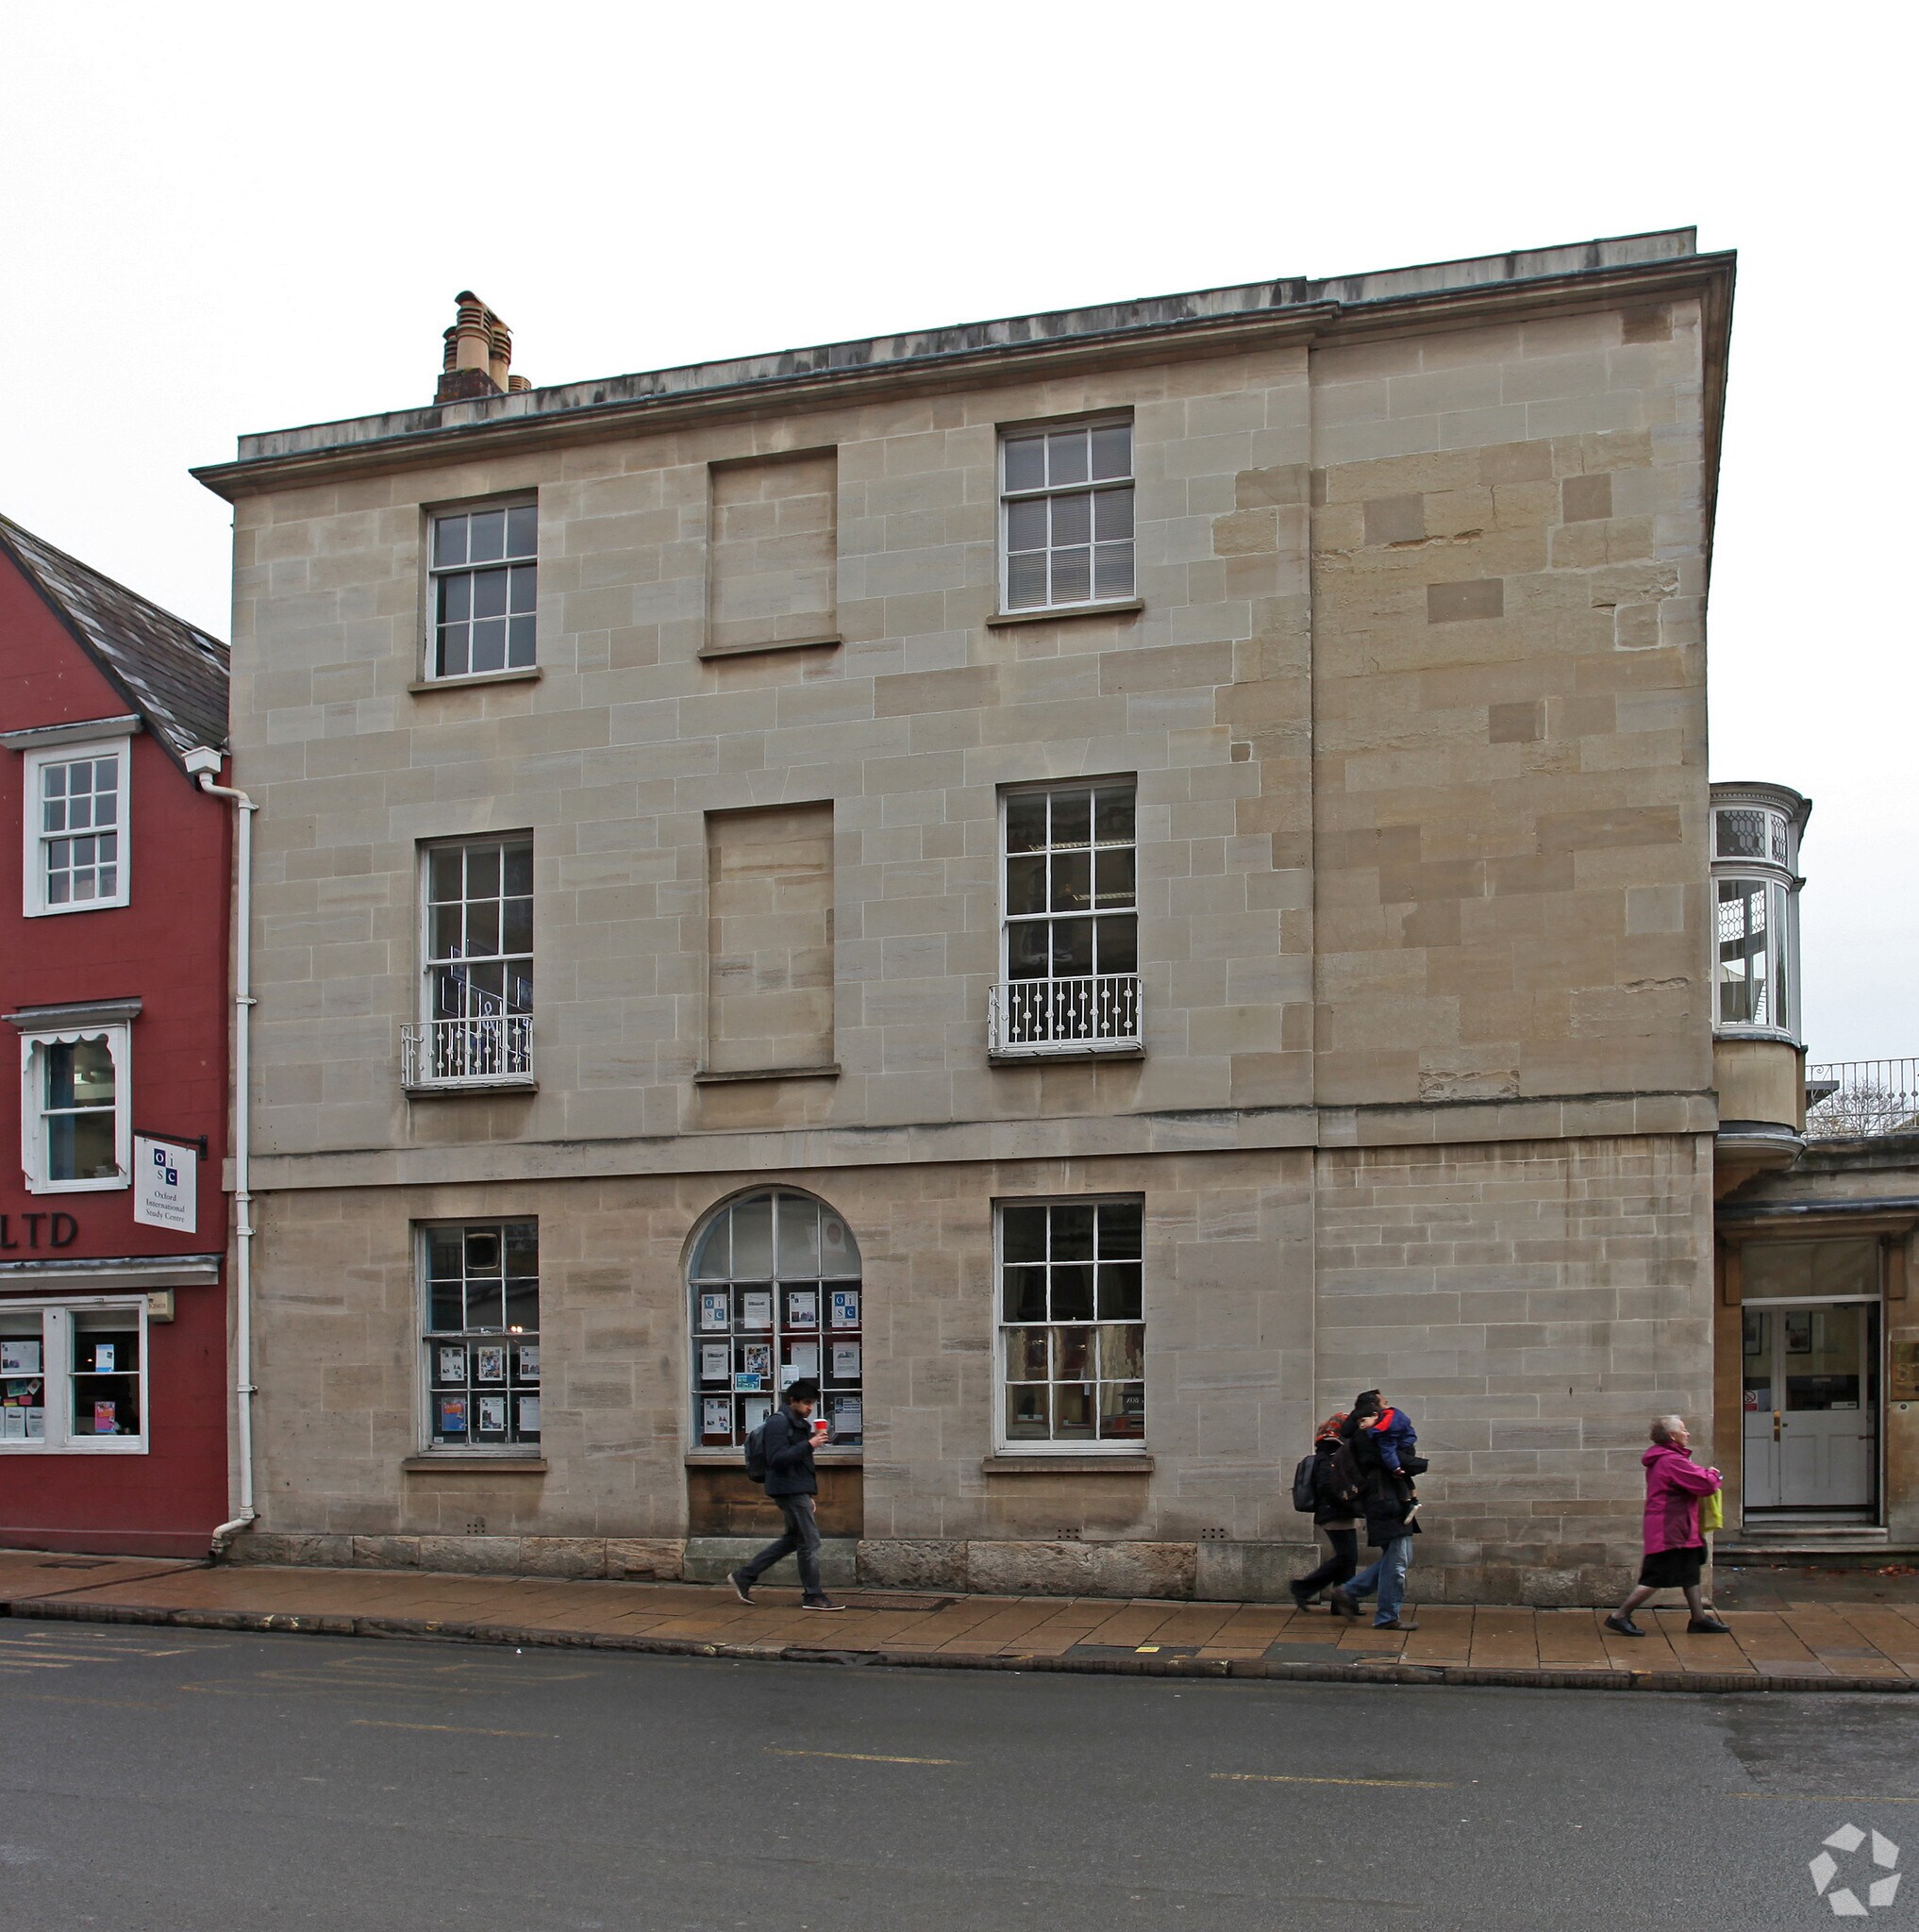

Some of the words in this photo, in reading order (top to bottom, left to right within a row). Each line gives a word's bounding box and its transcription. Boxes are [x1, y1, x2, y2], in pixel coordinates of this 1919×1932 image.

[154, 1191, 176, 1202] Oxford
[145, 1198, 185, 1213] International
[145, 1208, 163, 1220] Study
[164, 1212, 185, 1224] Centre
[0, 1212, 79, 1250] LTD
